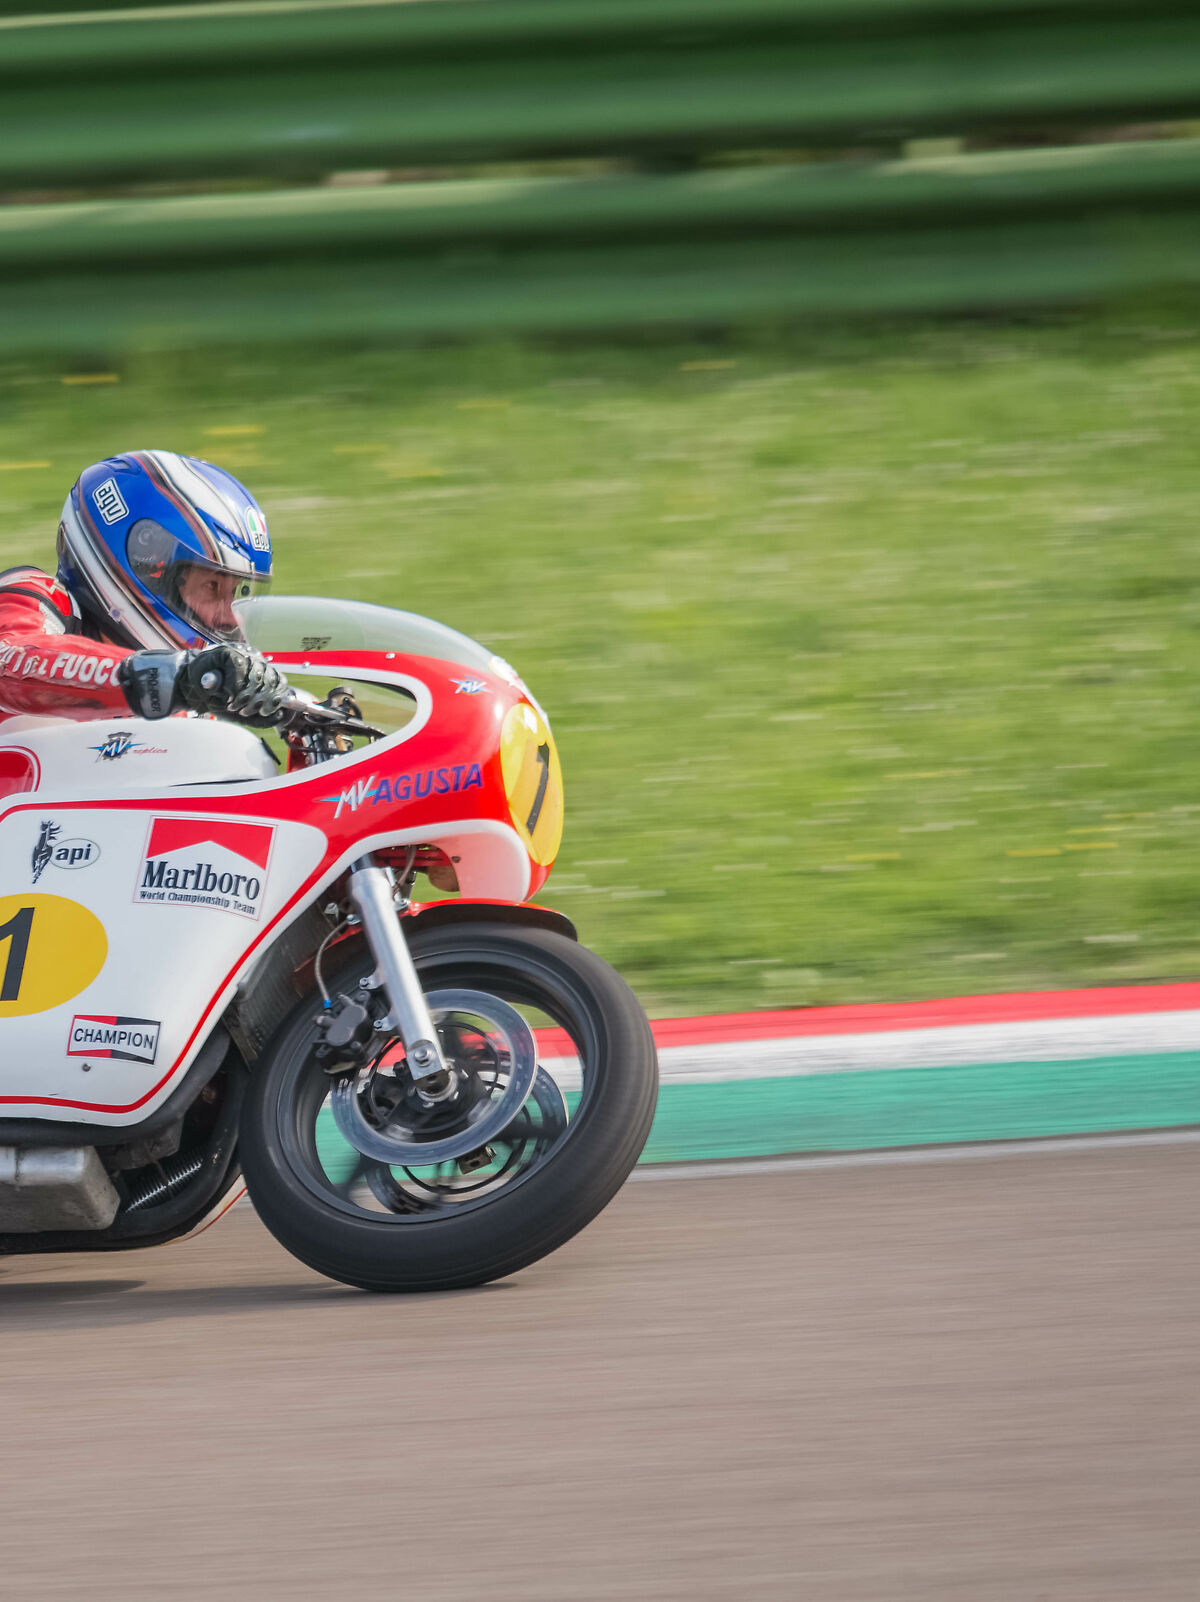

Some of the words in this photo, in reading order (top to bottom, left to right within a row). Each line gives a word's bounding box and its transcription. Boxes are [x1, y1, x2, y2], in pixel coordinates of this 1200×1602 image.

[98, 486, 122, 517] agv
[96, 738, 130, 762] MV
[334, 776, 375, 819] MV
[372, 763, 482, 805] AGUSTA
[526, 742, 550, 837] 1
[55, 843, 91, 865] api
[141, 860, 260, 901] Marlboro
[140, 890, 165, 901] World
[168, 892, 230, 908] Championship
[233, 900, 256, 915] Team
[73, 1027, 155, 1050] CHAMPION
